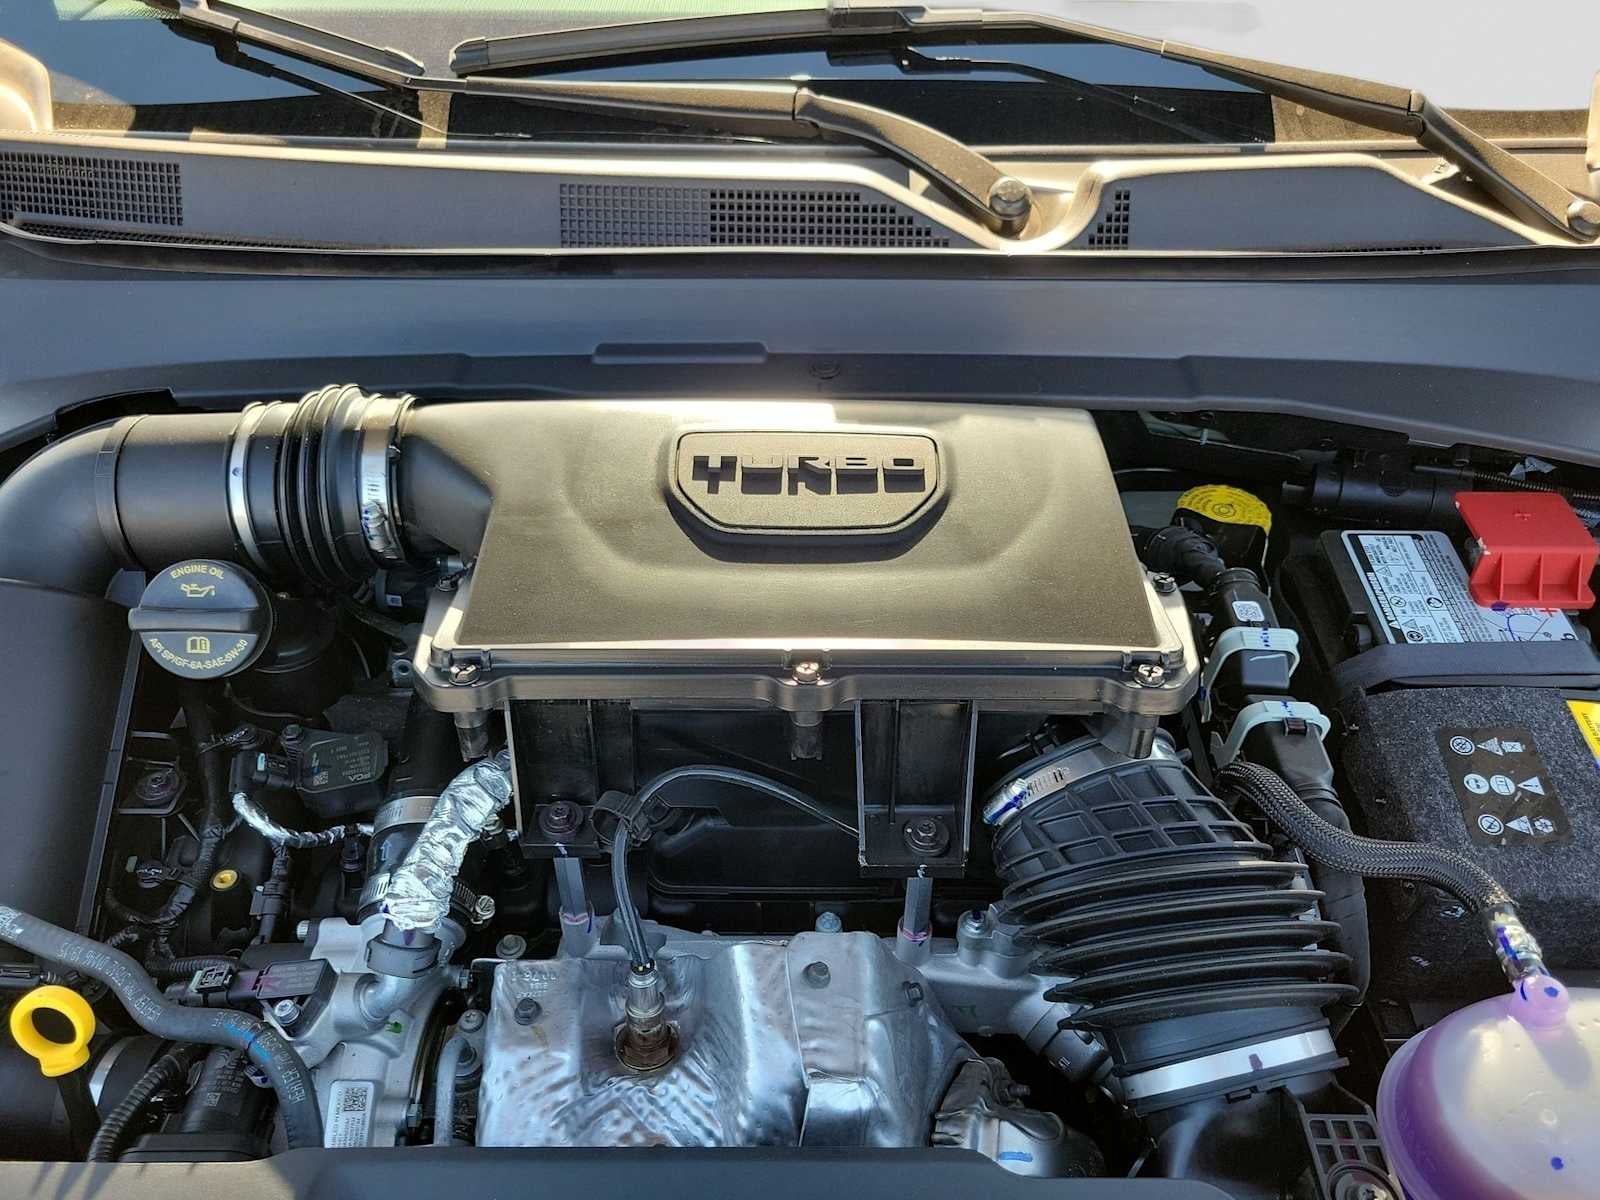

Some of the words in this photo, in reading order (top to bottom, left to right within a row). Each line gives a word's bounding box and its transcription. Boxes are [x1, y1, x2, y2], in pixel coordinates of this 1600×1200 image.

[691, 451, 927, 496] TURBO
[170, 564, 208, 579] ENGINE
[208, 567, 225, 580] OIL
[149, 638, 162, 654] API
